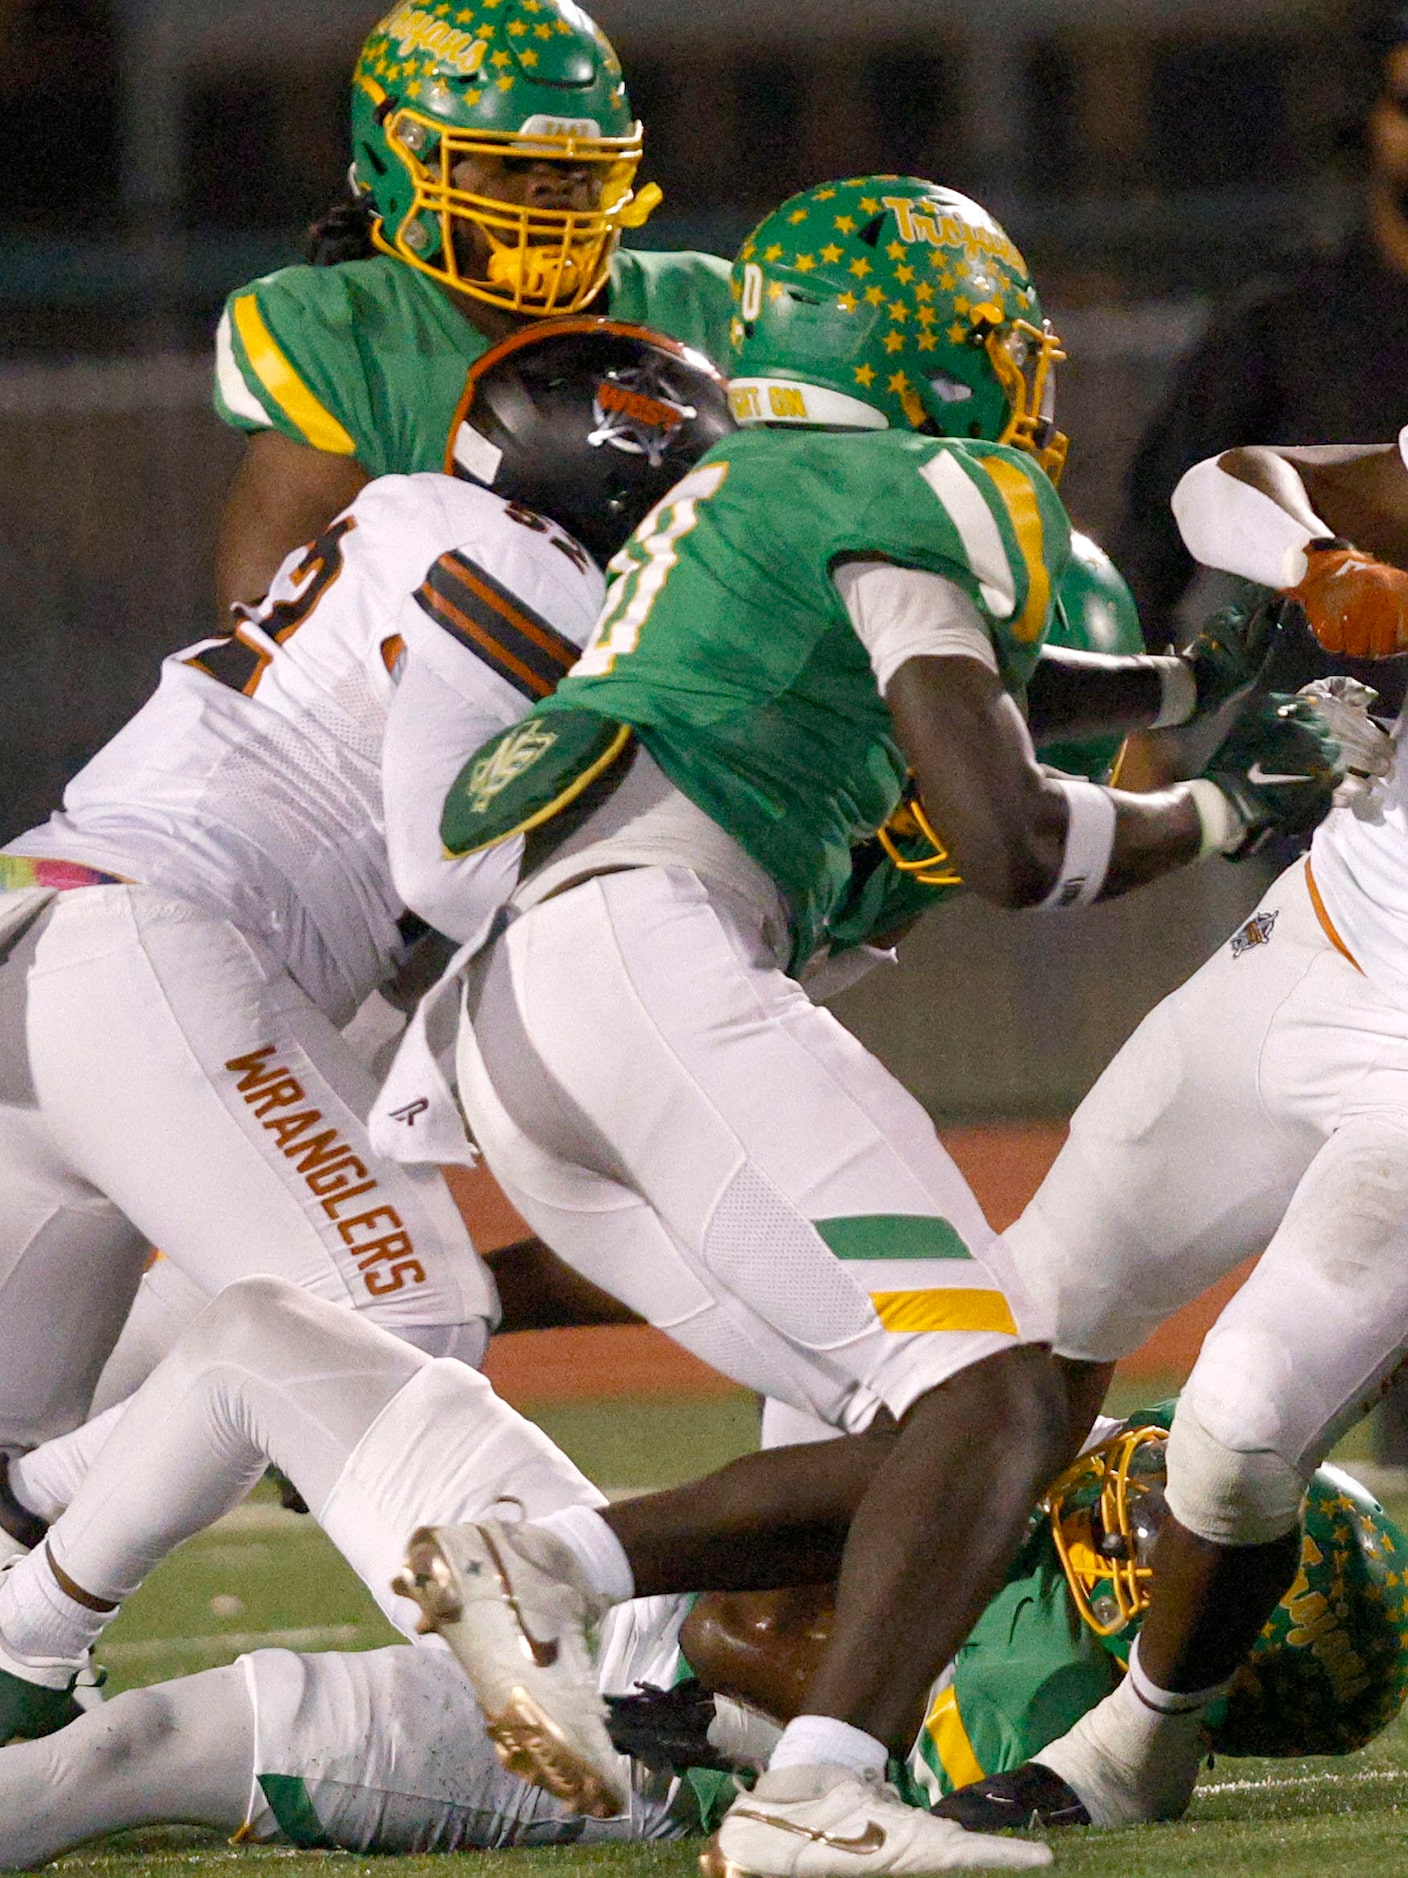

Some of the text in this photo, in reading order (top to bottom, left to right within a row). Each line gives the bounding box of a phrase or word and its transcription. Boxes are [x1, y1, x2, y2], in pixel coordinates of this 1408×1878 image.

[742, 263, 763, 321] 0
[768, 386, 807, 418] ON
[225, 1044, 426, 1296] WRANGLERS
